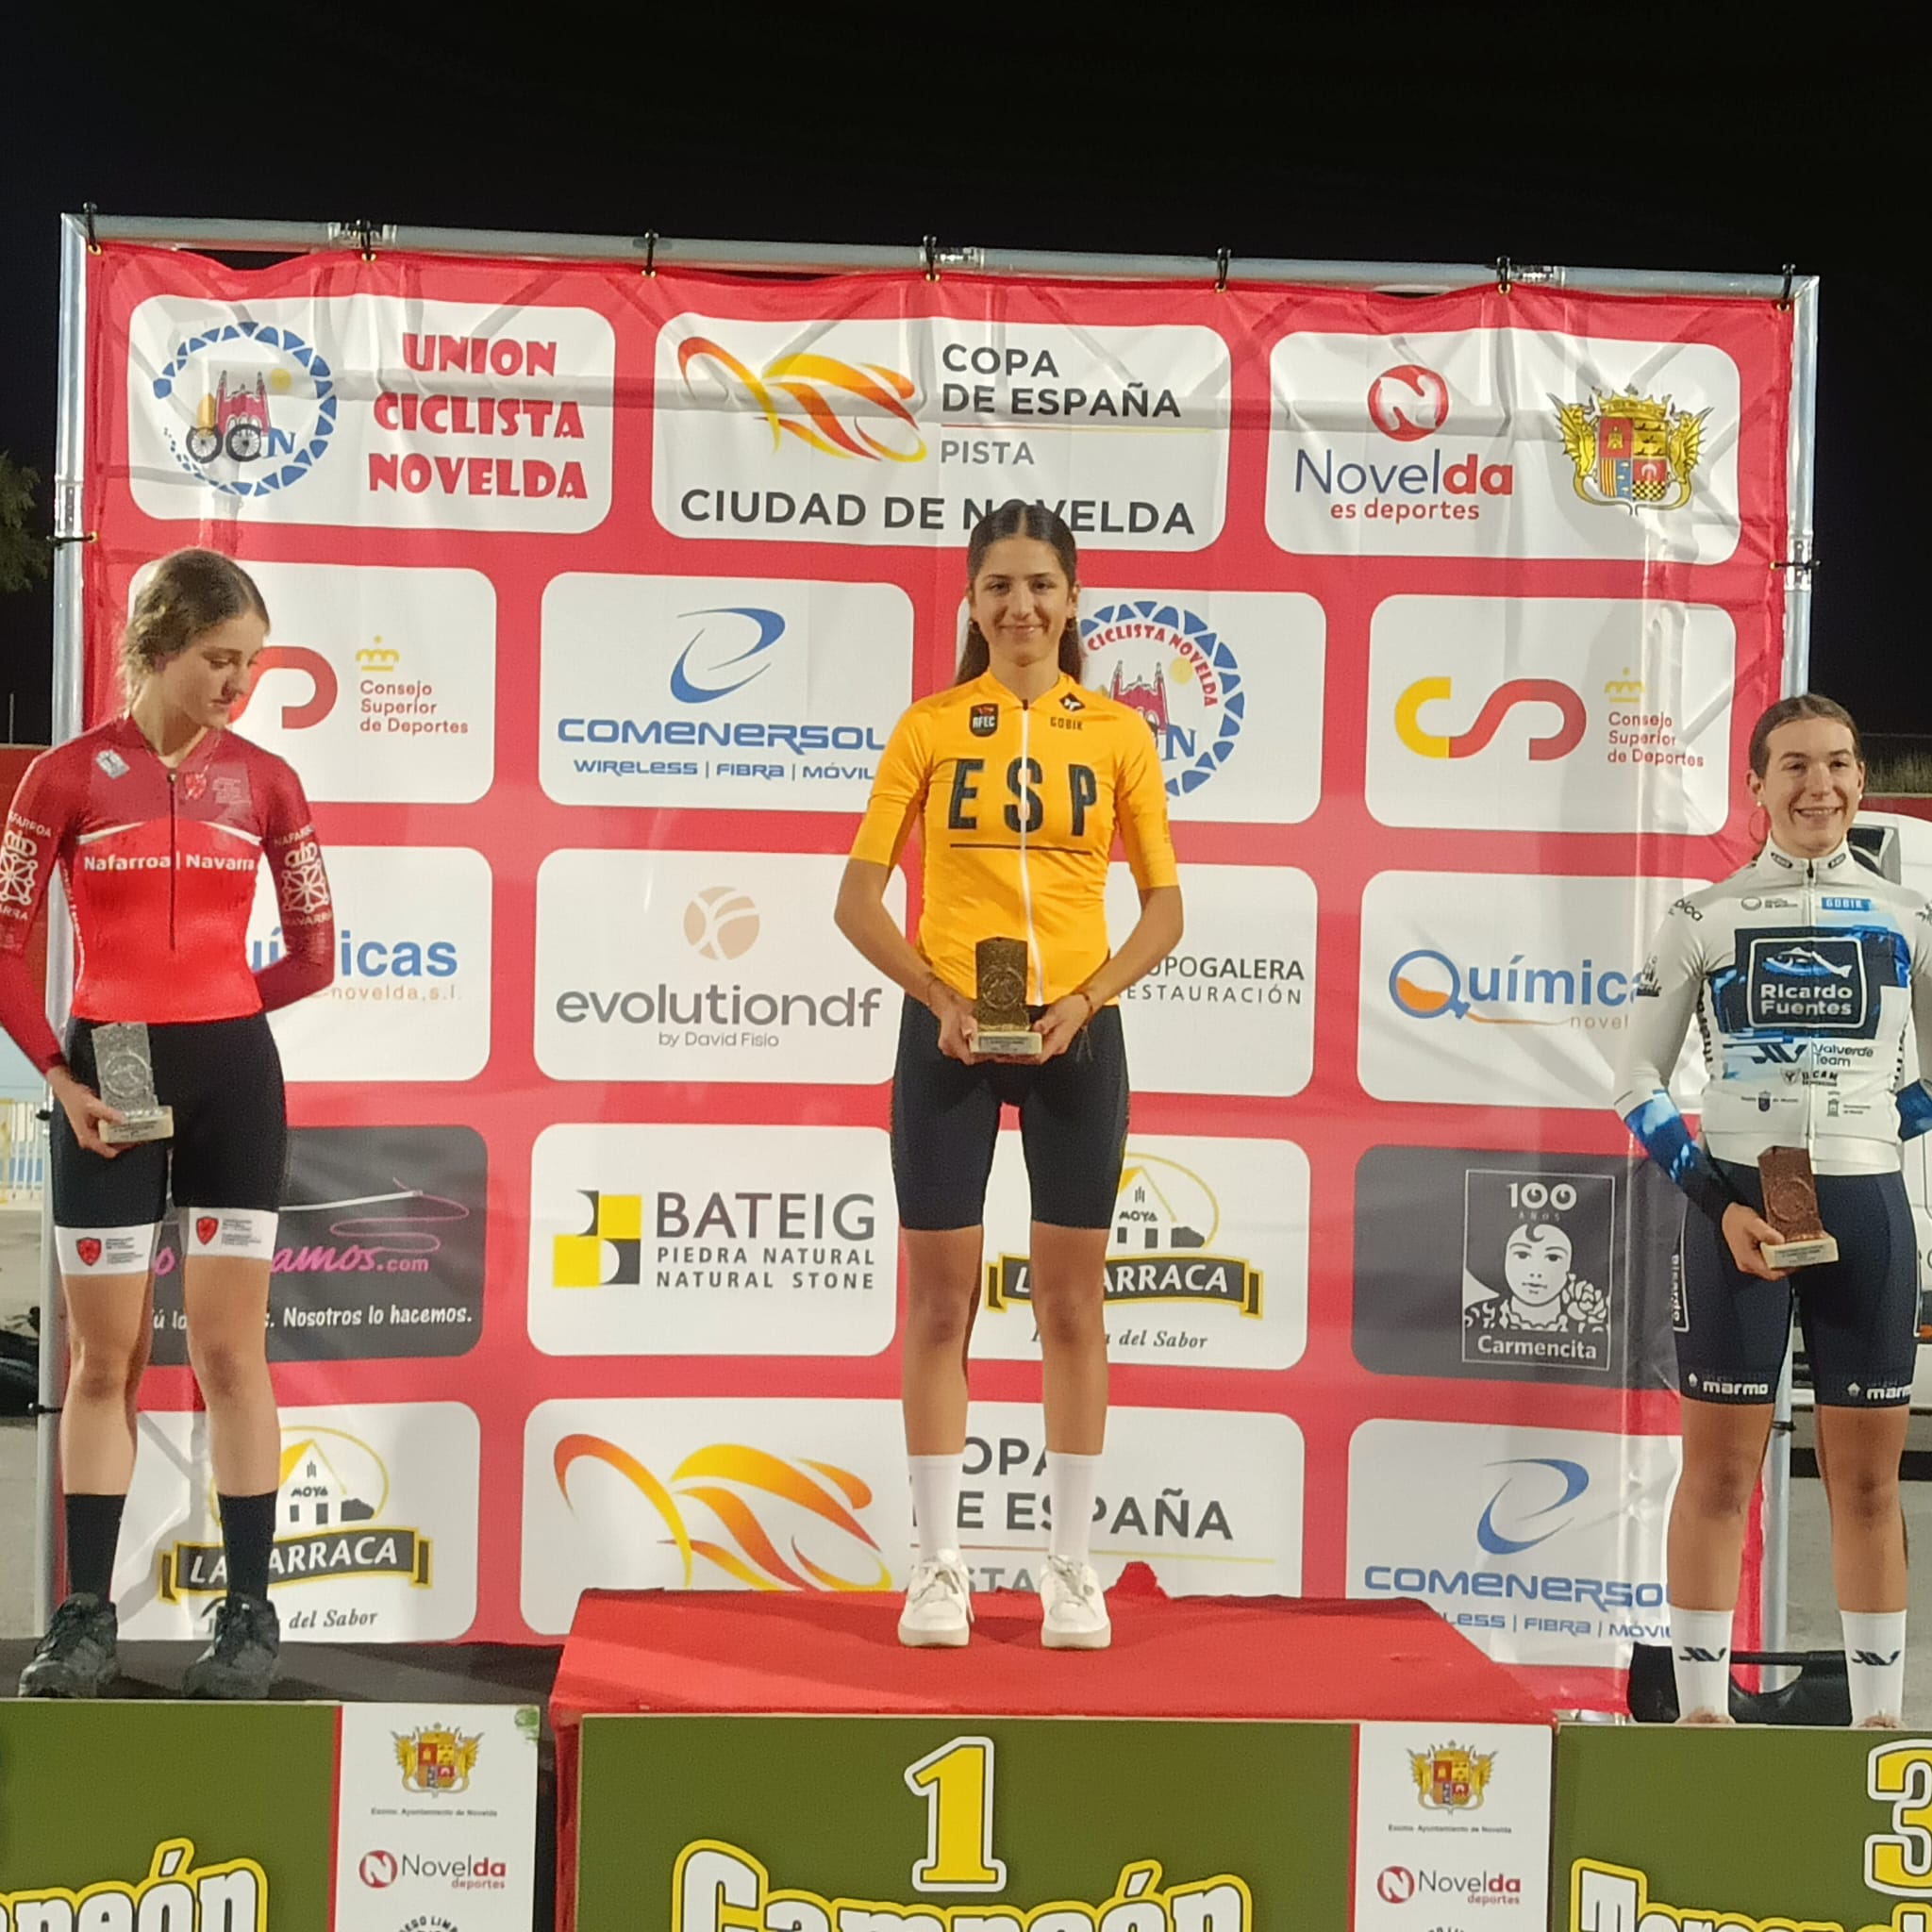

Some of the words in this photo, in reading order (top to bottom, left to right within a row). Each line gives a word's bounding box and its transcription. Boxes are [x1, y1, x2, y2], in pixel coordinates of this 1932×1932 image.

[403, 332, 557, 377] UNION
[942, 343, 1058, 377] COPA
[942, 384, 994, 413] DE
[1011, 381, 1181, 418] ESPAÑA
[373, 391, 585, 439] CICLISTA
[941, 440, 1035, 465] PISTA
[368, 453, 589, 499] NOVELDA
[1294, 448, 1514, 495] Novelda
[681, 489, 866, 528] CIUDAD
[884, 497, 944, 530] DE
[1330, 502, 1357, 520] es
[1364, 498, 1480, 524] deportes
[1087, 624, 1166, 651] CICLISTA
[1168, 633, 1219, 708] NOVELDA
[360, 679, 433, 698] Consejo
[360, 698, 437, 717] Superior
[360, 718, 382, 733] de
[388, 718, 468, 735] Deportes
[1608, 711, 1673, 731] Consejo
[1608, 729, 1677, 748] Superior
[1607, 749, 1627, 764] de
[1632, 750, 1705, 767] Deportes
[803, 761, 874, 781] MÓVIL
[948, 757, 1097, 837] ESP
[84, 854, 171, 872] Nafarroa
[1120, 984, 1302, 1006] ESTAURACIÓN
[1389, 949, 1641, 1019] Químic
[1760, 983, 1853, 1000] Ricardo
[557, 984, 882, 1027] evolutiondf
[1760, 1000, 1852, 1016] Fuentes
[1570, 1016, 1629, 1030] novel
[658, 1031, 679, 1048] by
[685, 1032, 737, 1047] David
[741, 1032, 779, 1048] Fisio
[1812, 1041, 1874, 1058] Valverde
[1812, 1053, 1851, 1067] Team
[1507, 1182, 1577, 1211] 100
[657, 1191, 874, 1241] BATEIG
[1119, 1210, 1158, 1222] MOYA
[658, 1247, 748, 1264] PIEDRA
[763, 1247, 874, 1266] NATURAL
[657, 1271, 774, 1289] NATURAL
[792, 1272, 874, 1291] STONE
[1104, 1264, 1227, 1293] ARRACA
[283, 1306, 362, 1328] Nosotros
[368, 1306, 385, 1326] lo
[390, 1304, 473, 1325] hacemos.
[1119, 1329, 1147, 1347] del
[1153, 1328, 1208, 1349] Sabor
[1477, 1335, 1597, 1359] Carmencita
[1703, 1380, 1769, 1395] marmo
[291, 1486, 328, 1498] MOYA
[190, 1557, 227, 1584] LA
[269, 1537, 398, 1574] ARRACA
[1364, 1565, 1670, 1612] COMENERSO
[289, 1611, 316, 1630] del
[324, 1608, 379, 1628] Sabor
[906, 1736, 1007, 1891] 1
[1865, 1739, 1932, 1898] 3
[402, 1854, 507, 1877] Novelda
[451, 1877, 506, 1890] deportes
[1419, 1870, 1521, 1893] Novelda
[1467, 1893, 1521, 1907] deportes
